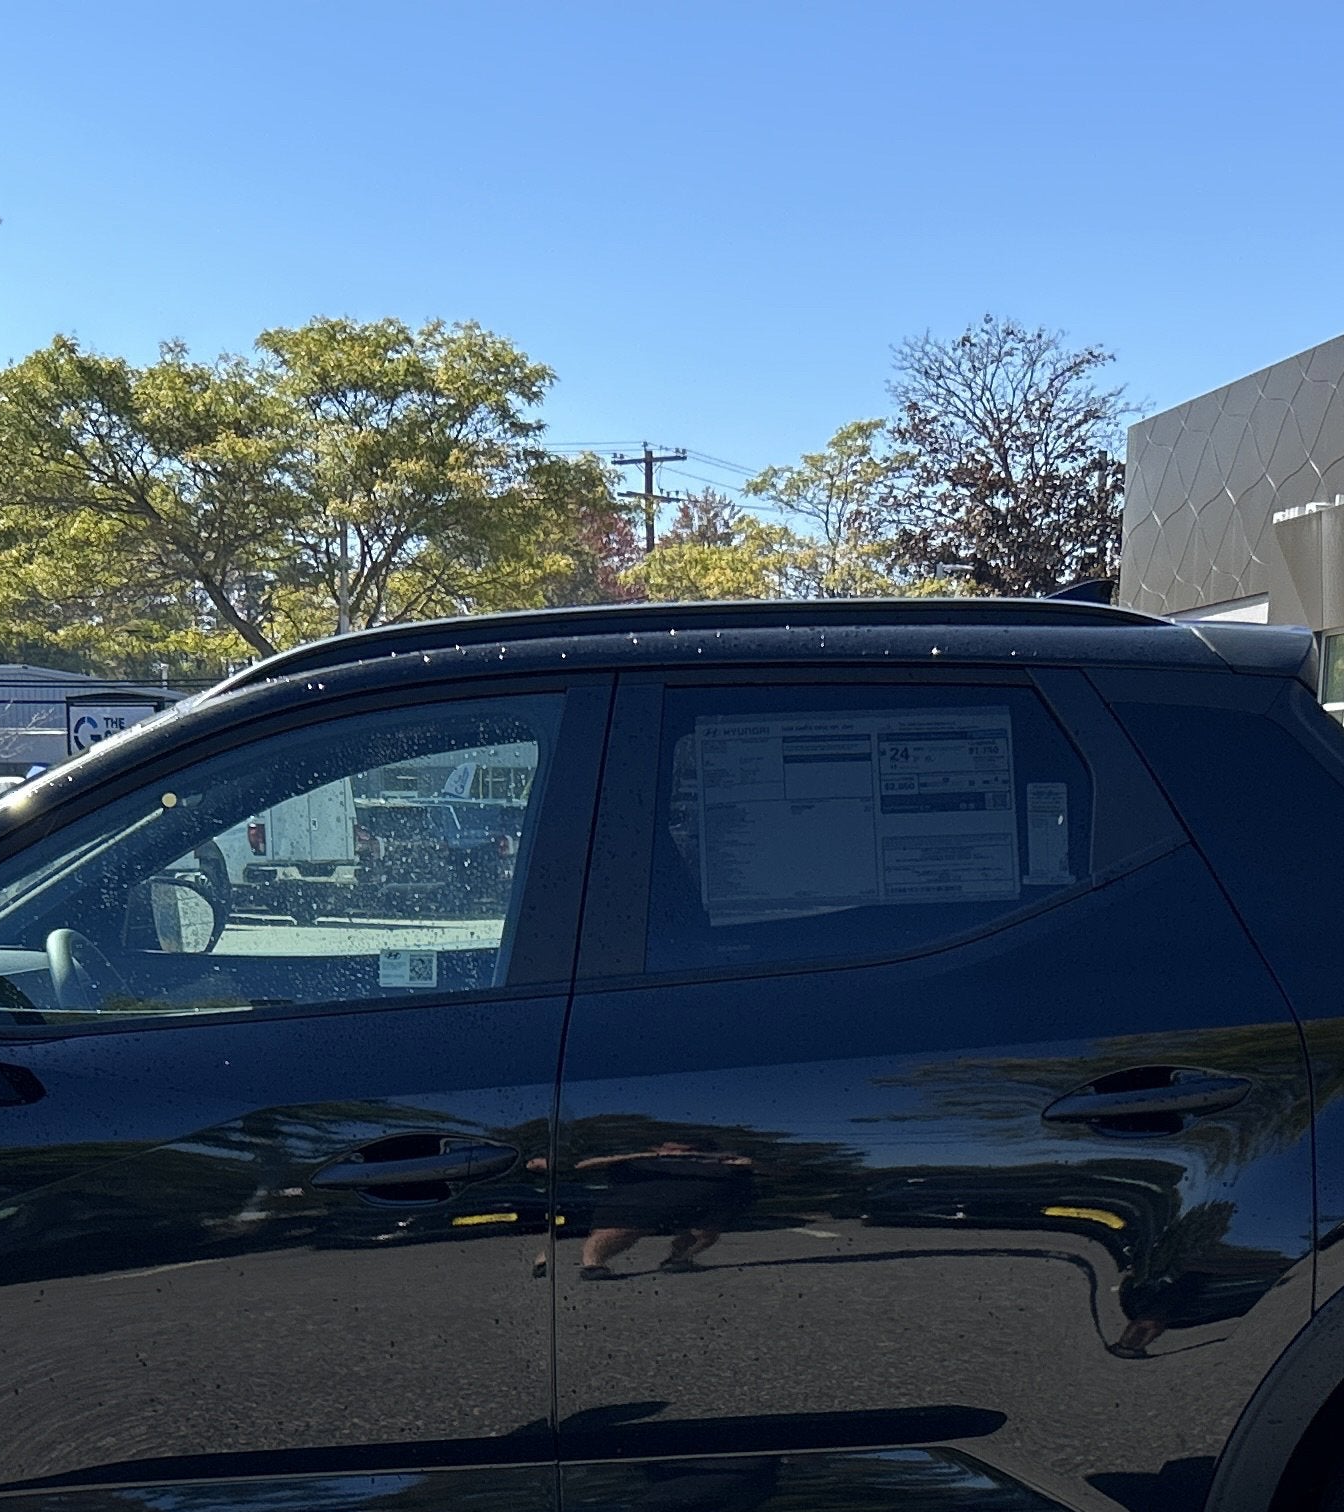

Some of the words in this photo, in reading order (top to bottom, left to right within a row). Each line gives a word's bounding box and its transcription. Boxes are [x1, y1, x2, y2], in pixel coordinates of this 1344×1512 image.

[103, 717, 125, 729] THE
[723, 726, 770, 736] HYUNDAI
[890, 746, 910, 762] 24
